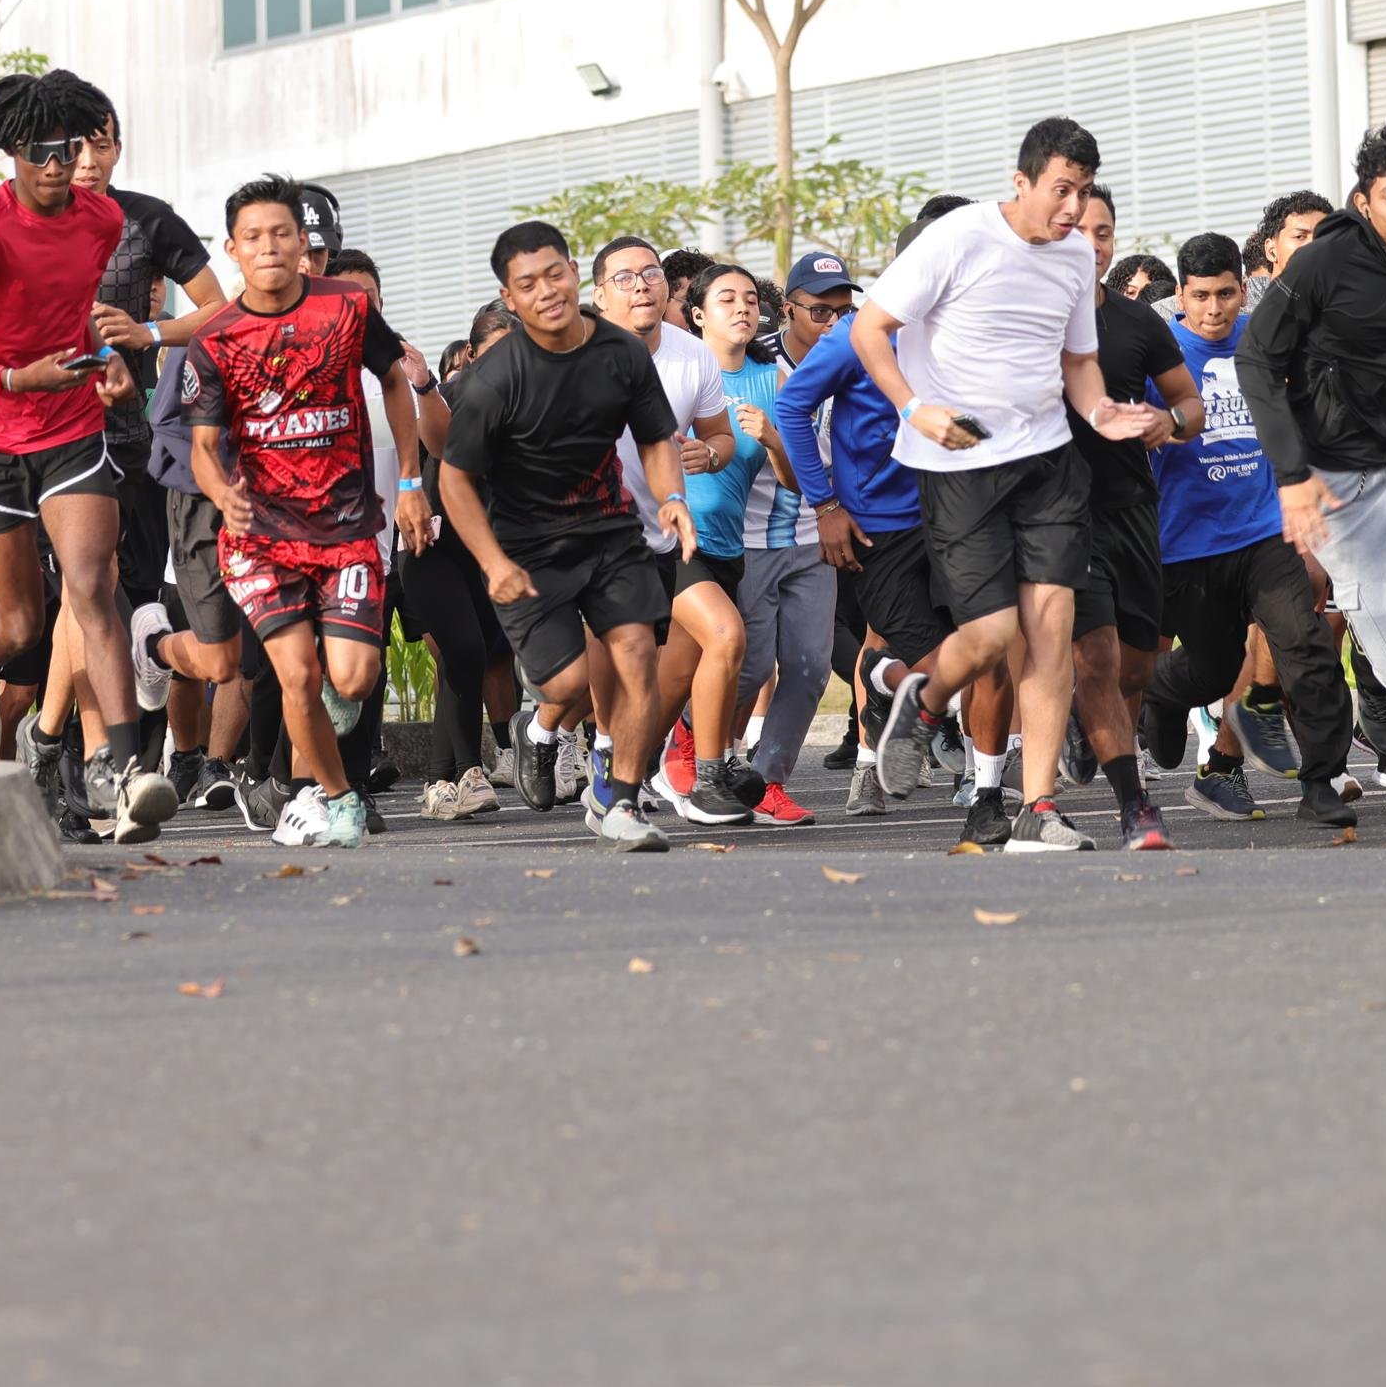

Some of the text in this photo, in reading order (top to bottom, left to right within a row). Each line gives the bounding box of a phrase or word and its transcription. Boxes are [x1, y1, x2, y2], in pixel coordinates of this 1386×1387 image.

[302, 203, 320, 225] LA
[245, 407, 350, 439] TITANES
[1199, 456, 1224, 464] Vacation
[1224, 453, 1239, 462] Bible
[338, 564, 368, 599] 10
